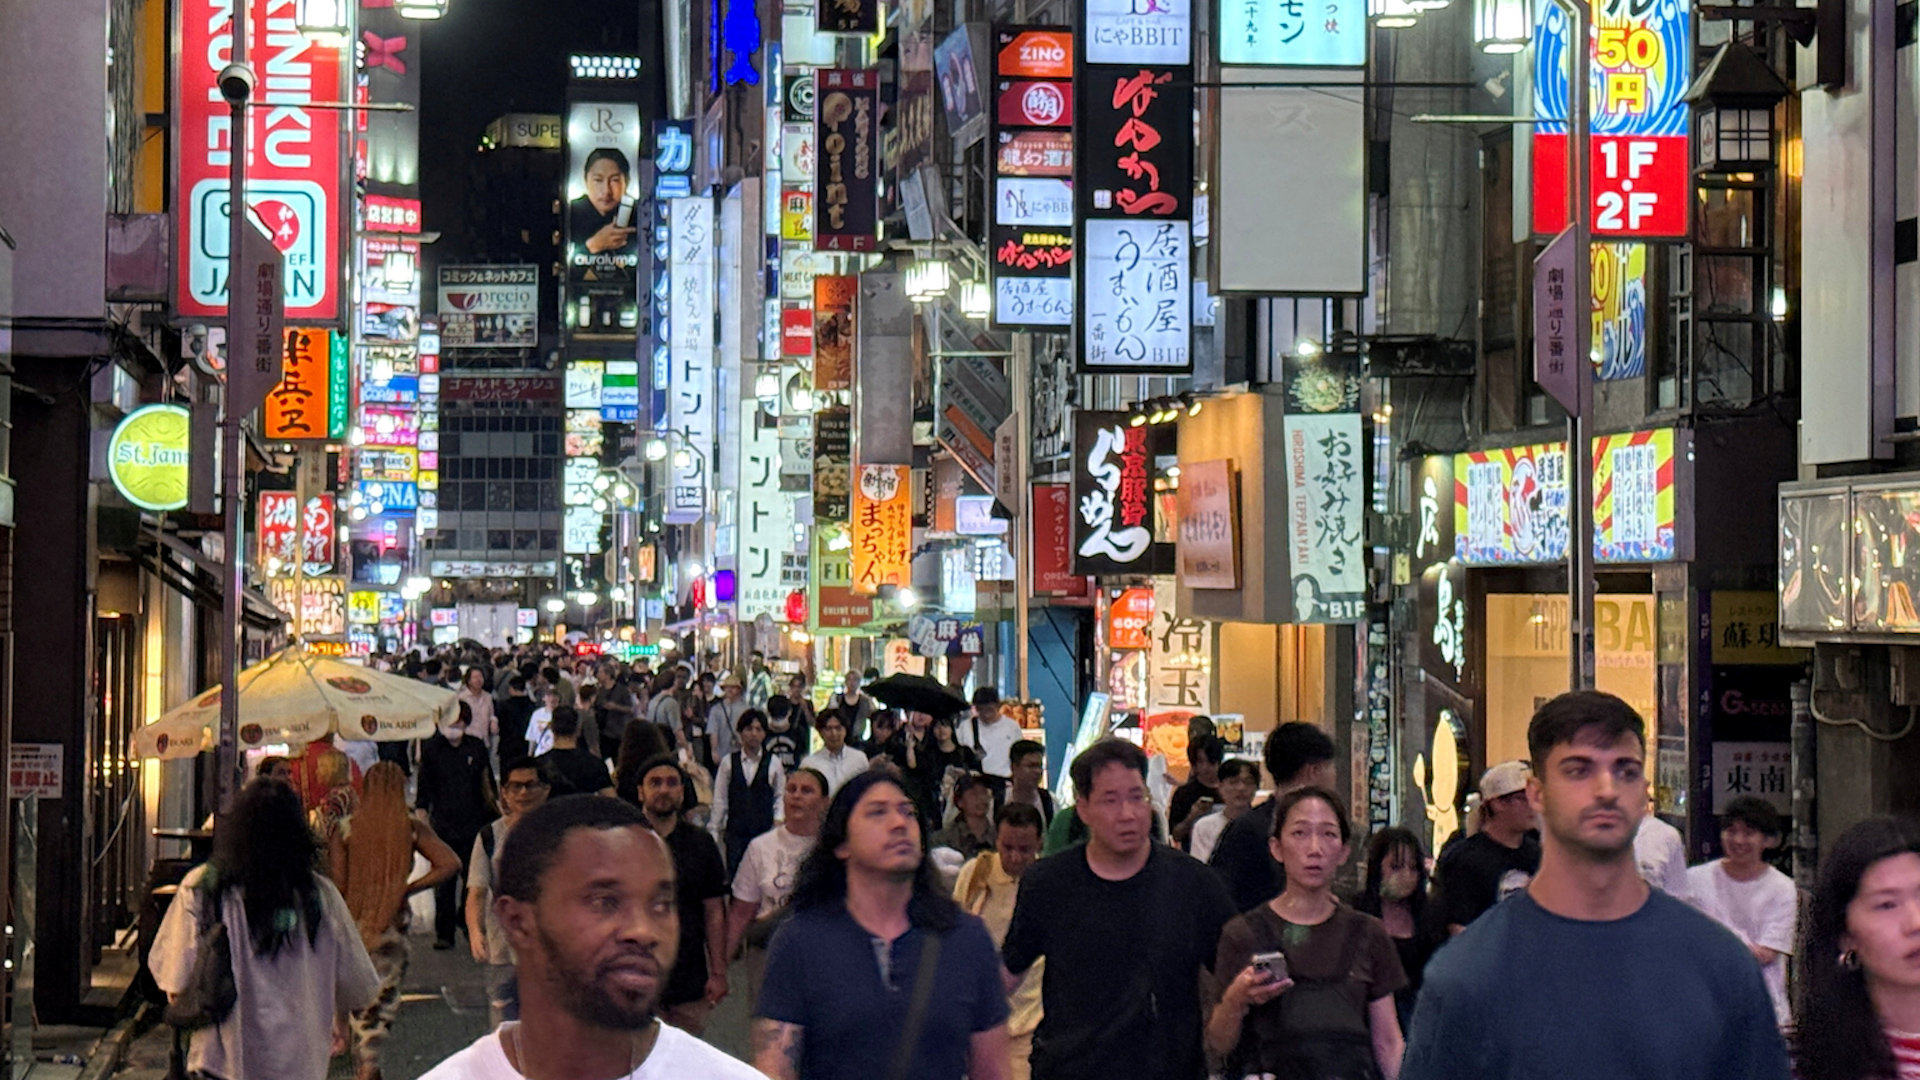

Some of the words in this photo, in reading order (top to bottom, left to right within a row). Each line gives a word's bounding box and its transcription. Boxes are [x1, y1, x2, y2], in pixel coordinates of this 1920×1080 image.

[1019, 47, 1066, 60] ZINO
[1597, 28, 1660, 69] 50
[1606, 72, 1646, 115] 円
[517, 123, 559, 139] SUPE
[1600, 142, 1657, 178] 1F
[1596, 193, 1657, 229] 2F
[200, 267, 316, 298] JAN
[1145, 224, 1182, 333] 居酒屋
[1293, 429, 1305, 488] HIROSHIMA
[828, 505, 846, 517] 2F
[1313, 428, 1360, 576] お好み焼き
[1329, 601, 1366, 619] B1F
[1726, 765, 1786, 794] 東南
